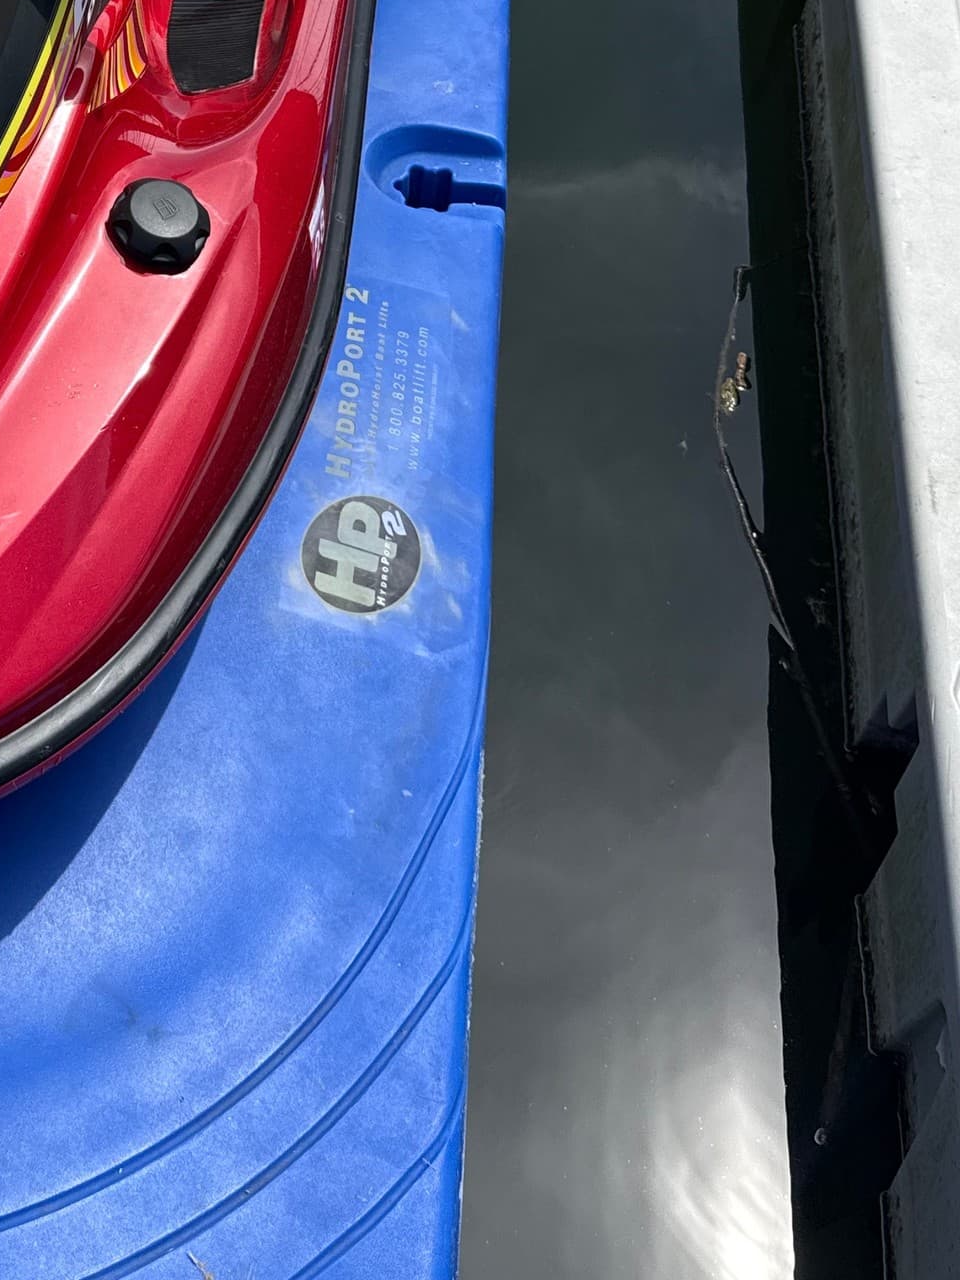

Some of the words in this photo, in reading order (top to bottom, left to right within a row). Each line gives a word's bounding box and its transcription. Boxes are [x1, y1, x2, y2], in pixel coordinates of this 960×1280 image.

[345, 287, 370, 305] 2
[378, 301, 390, 328] Lifts
[375, 333, 386, 361] Boat
[388, 330, 411, 437] 800.825.3379
[408, 326, 430, 472] www.boatlift.com
[381, 509, 408, 537] 2
[314, 501, 398, 607] HP
